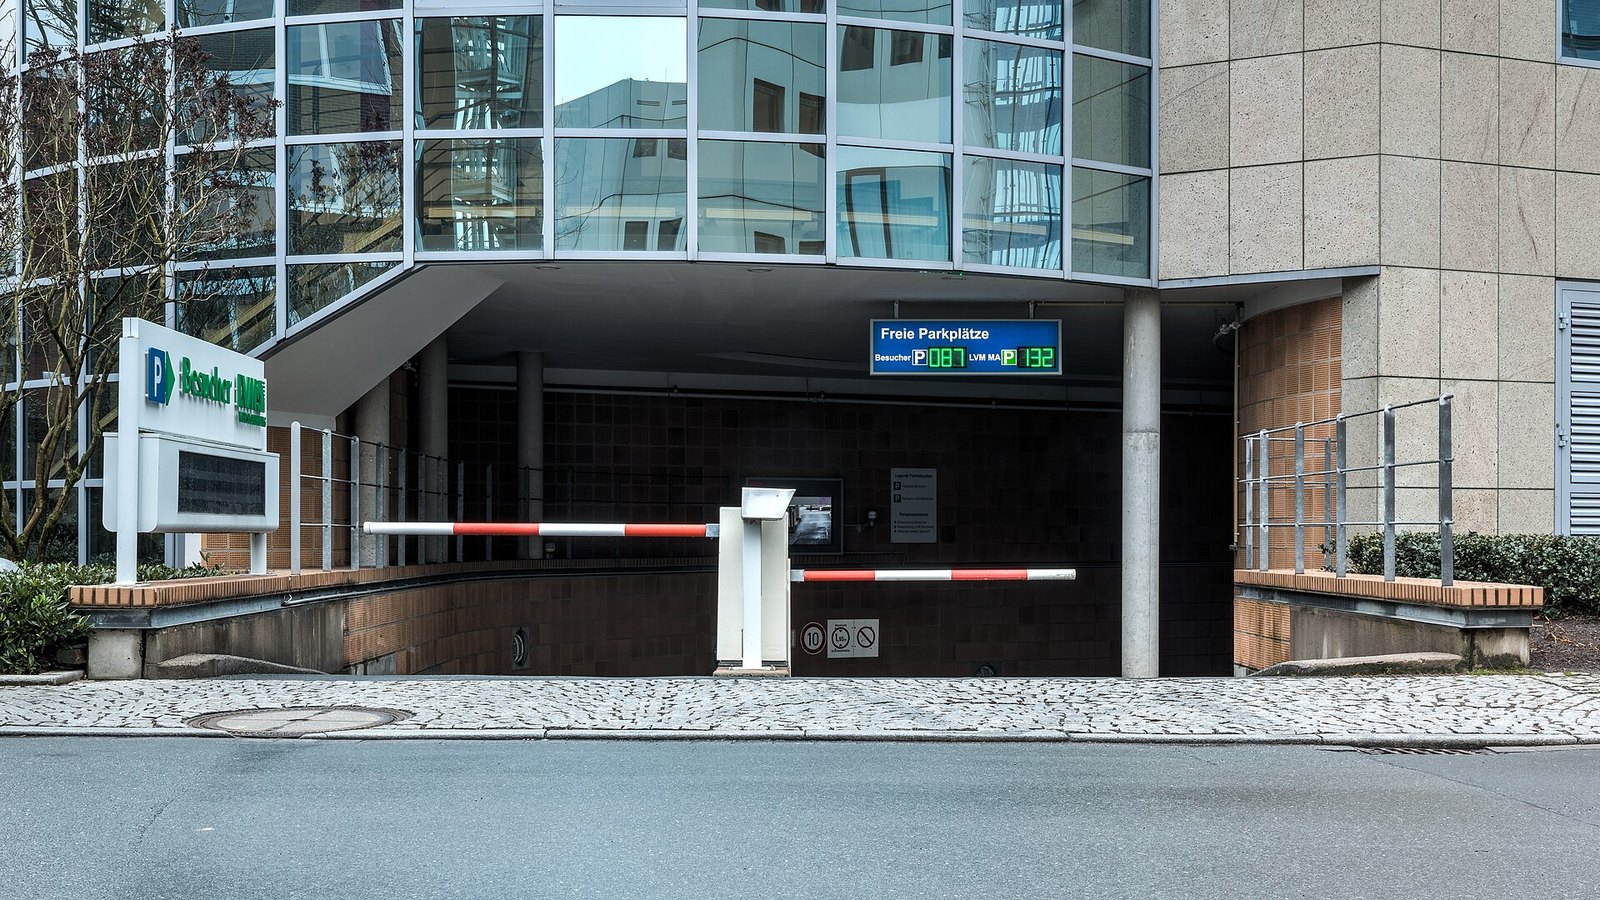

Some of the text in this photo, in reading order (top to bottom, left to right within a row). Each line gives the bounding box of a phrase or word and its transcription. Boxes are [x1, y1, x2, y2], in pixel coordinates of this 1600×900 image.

[881, 327, 989, 342] Freie Parkplätze
[875, 353, 911, 362] Besucher
[929, 348, 965, 368] 087
[969, 353, 986, 362] LVM
[988, 353, 1001, 362] MA
[1026, 348, 1053, 368] 132
[182, 357, 232, 404] Besucher
[807, 632, 819, 646] 10
